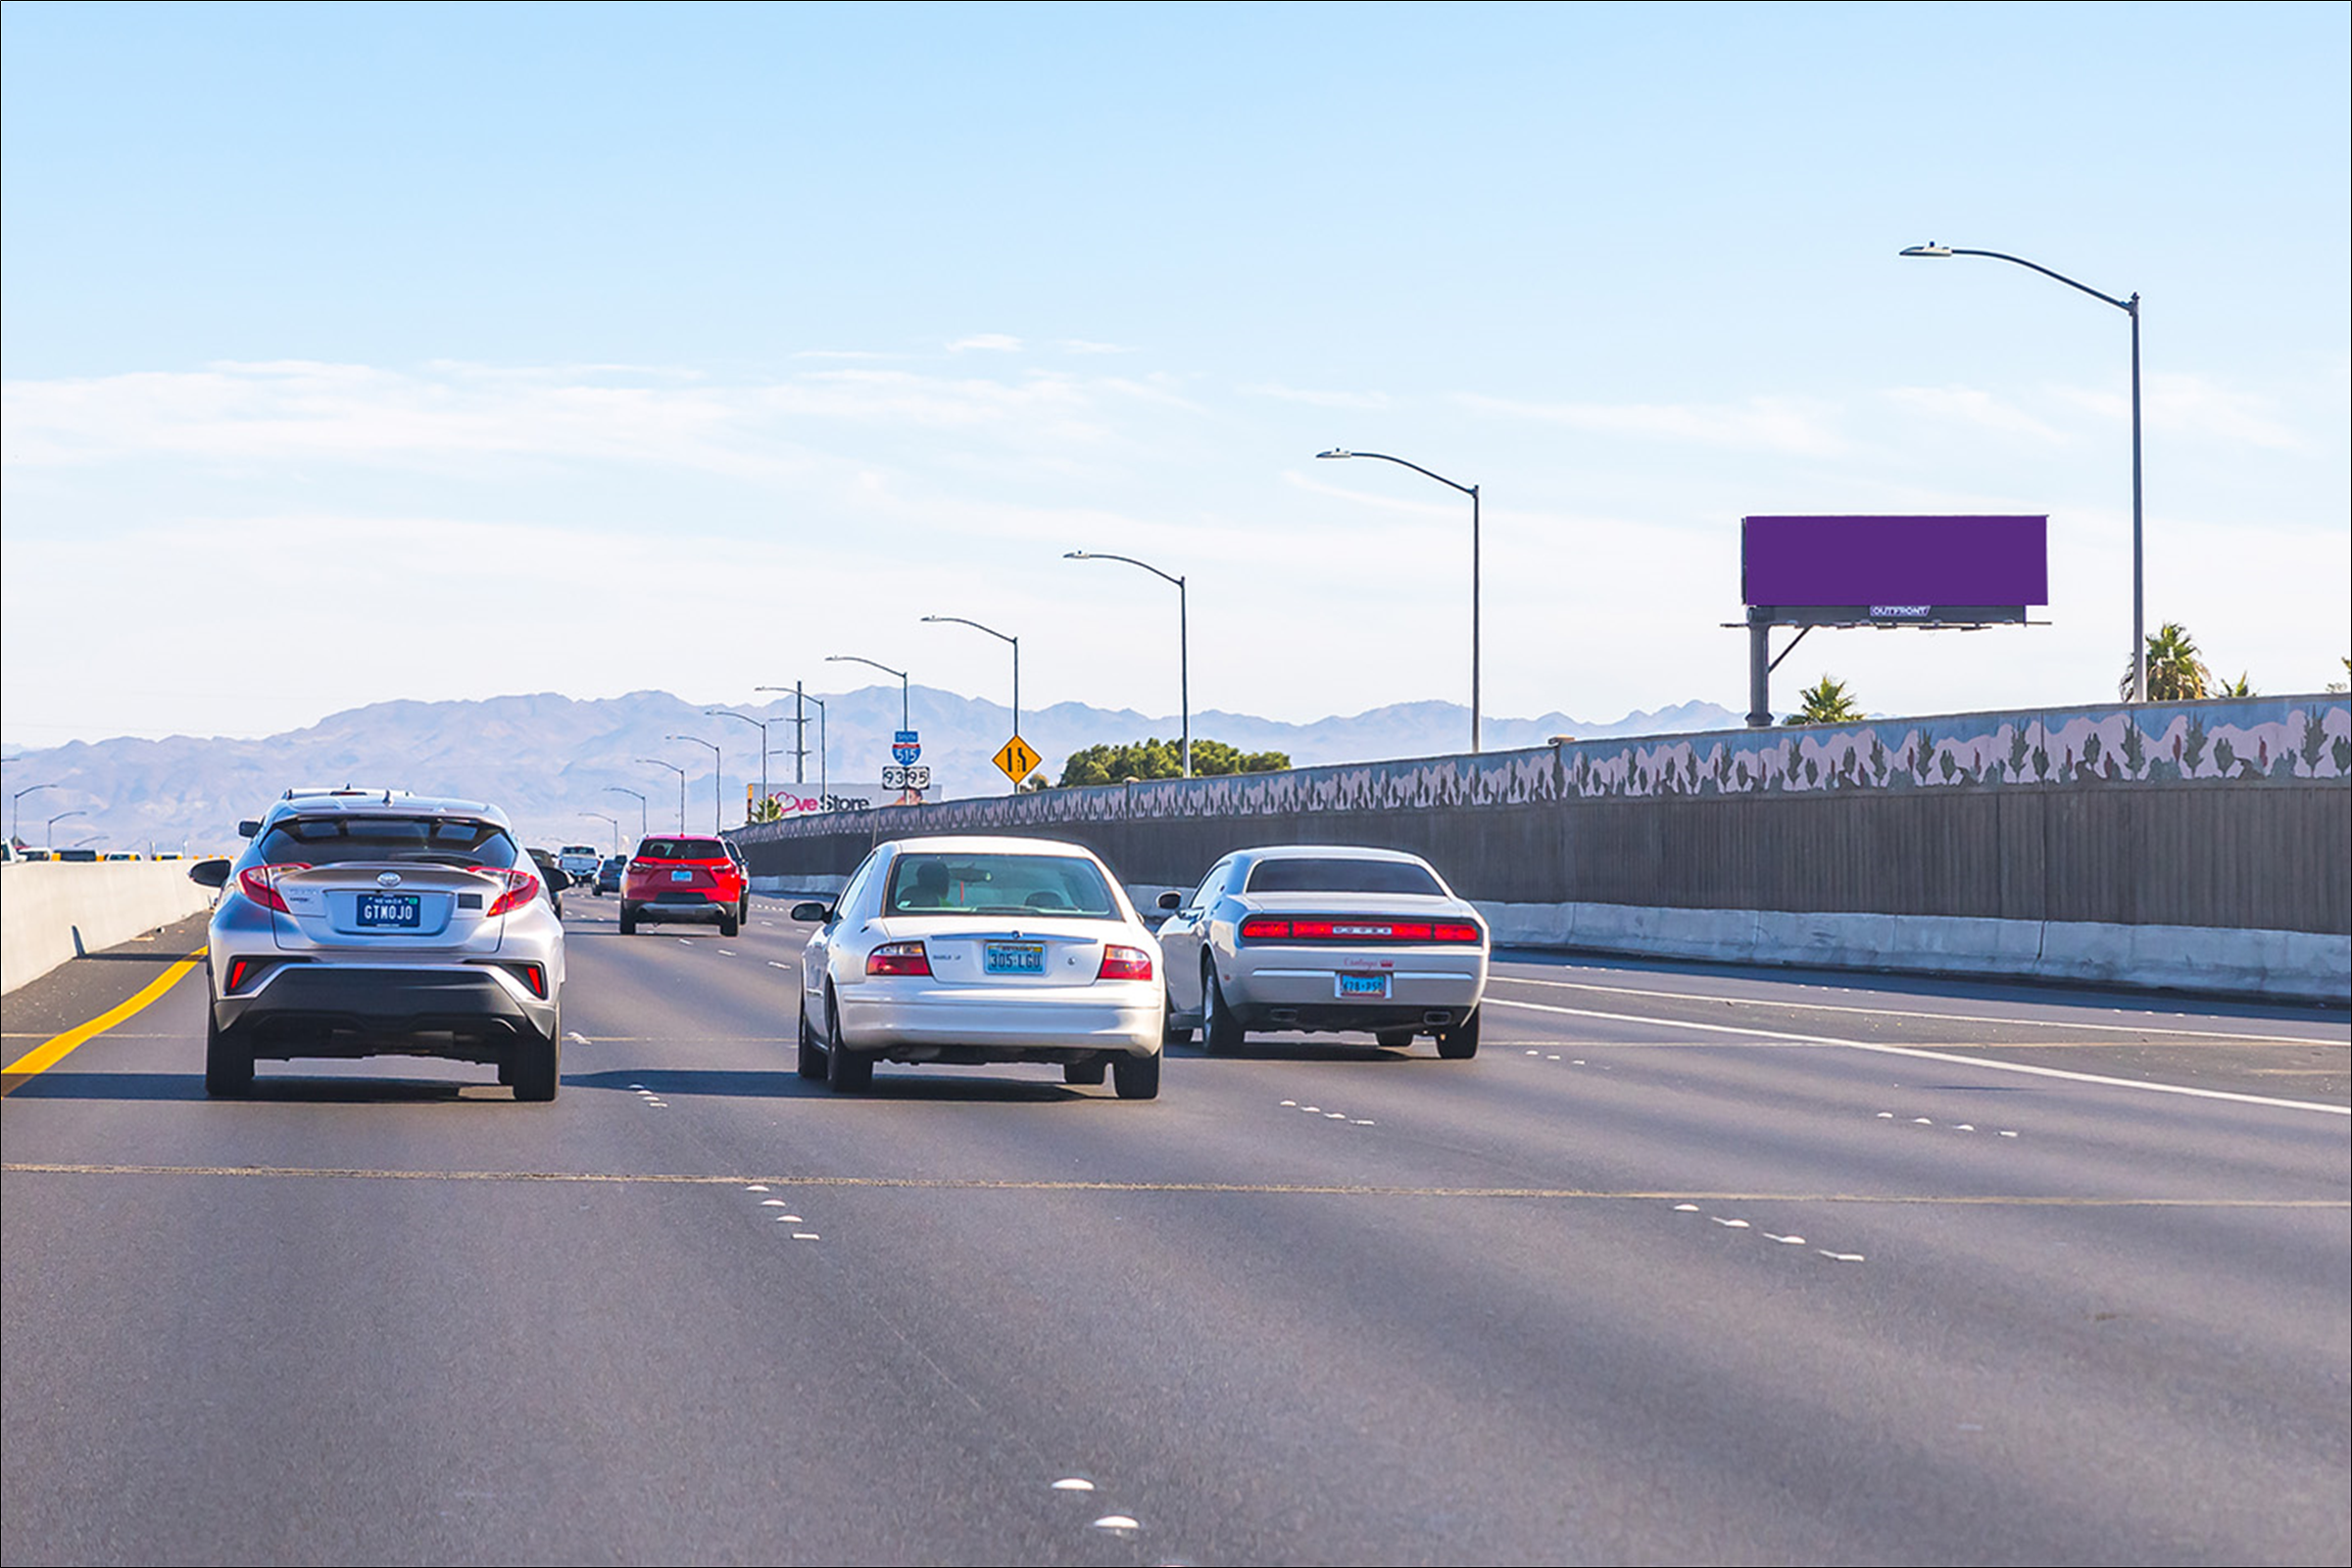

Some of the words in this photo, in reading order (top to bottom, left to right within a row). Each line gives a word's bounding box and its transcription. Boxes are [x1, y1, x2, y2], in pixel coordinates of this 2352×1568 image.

[896, 748, 917, 762] 515
[884, 770, 904, 784] 93
[909, 770, 928, 784] 95
